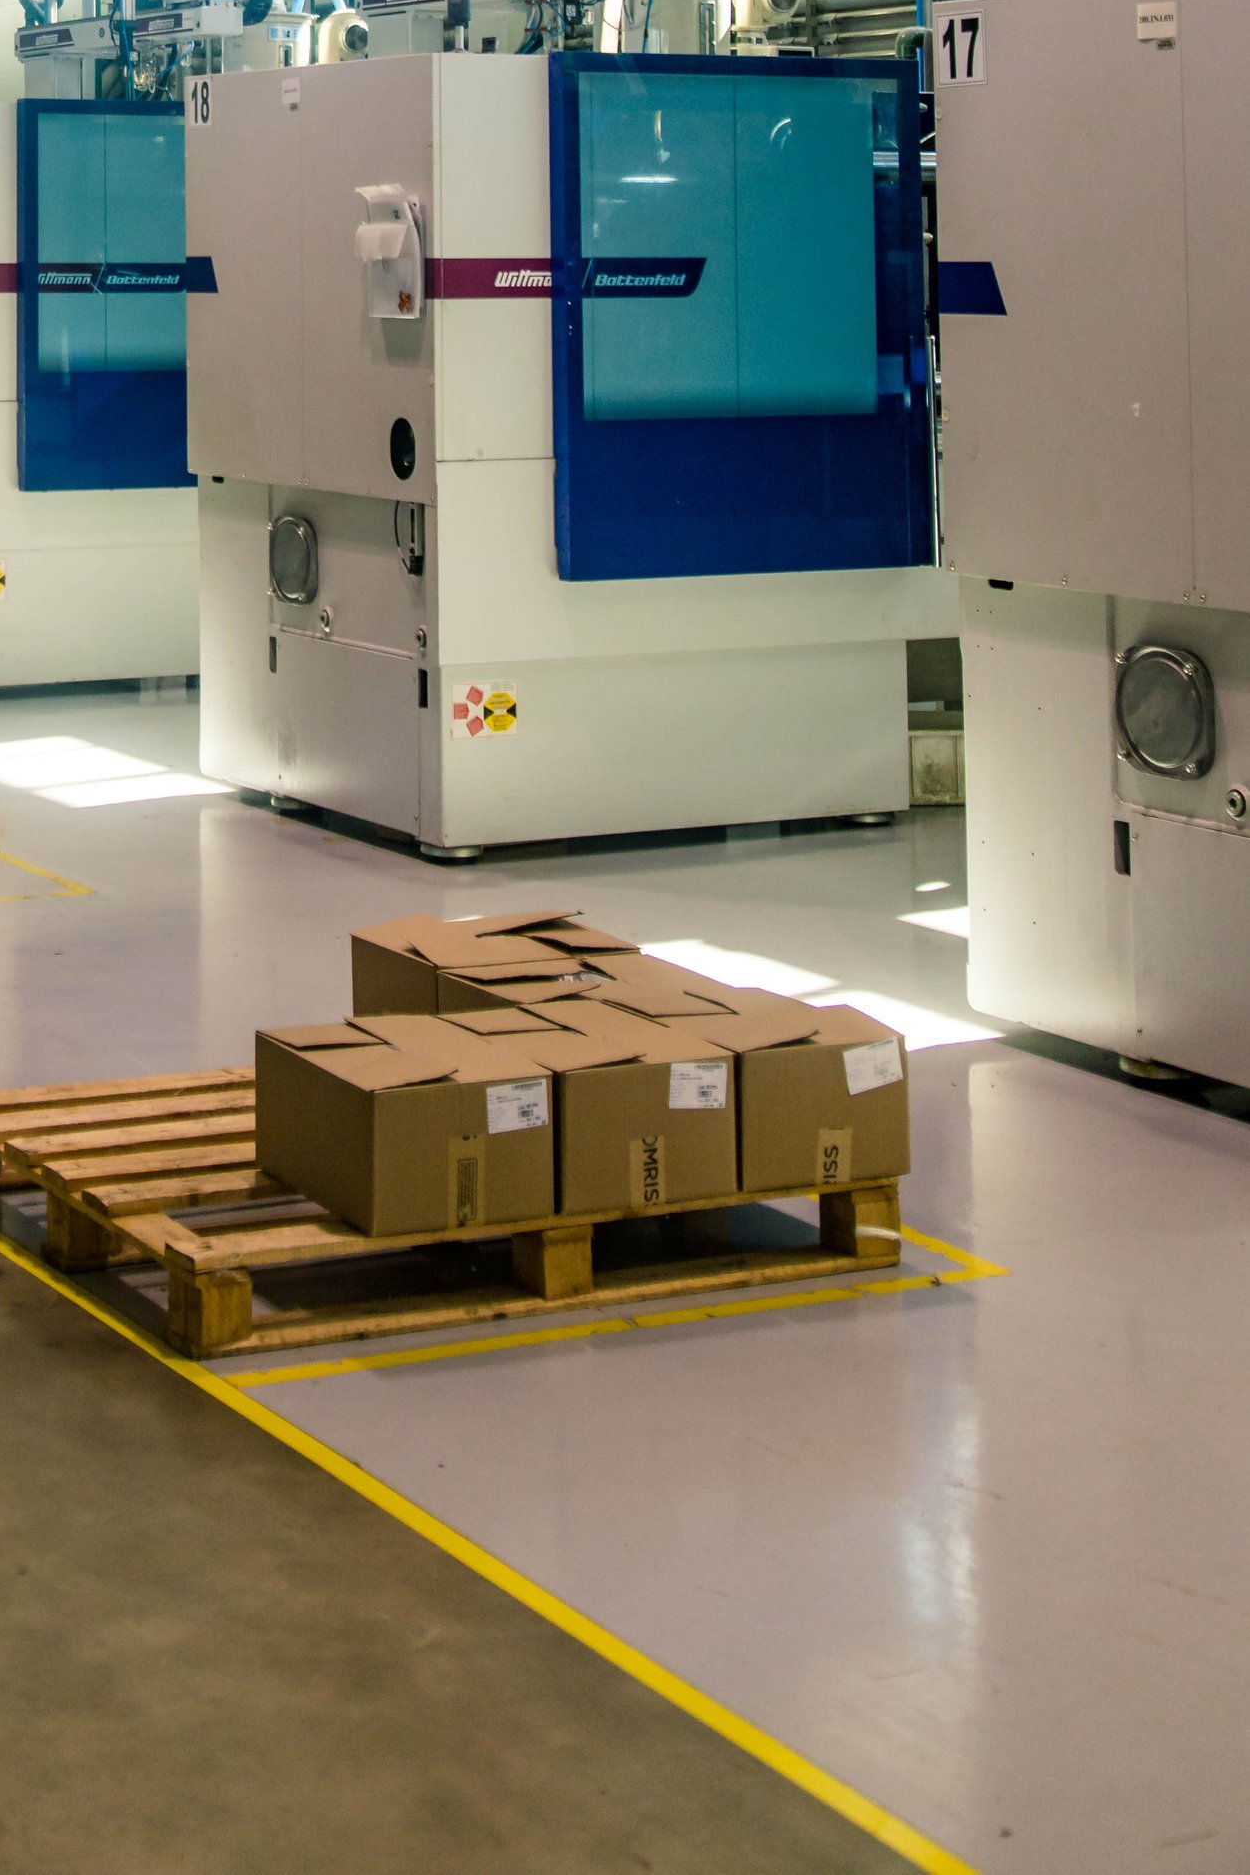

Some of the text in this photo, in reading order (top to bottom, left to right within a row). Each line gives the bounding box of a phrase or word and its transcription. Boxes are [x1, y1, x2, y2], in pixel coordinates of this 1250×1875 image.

[942, 18, 979, 80] 17
[191, 81, 209, 124] 18
[106, 275, 180, 285] Battenfeld
[494, 269, 687, 287] Wittma Battenfeld
